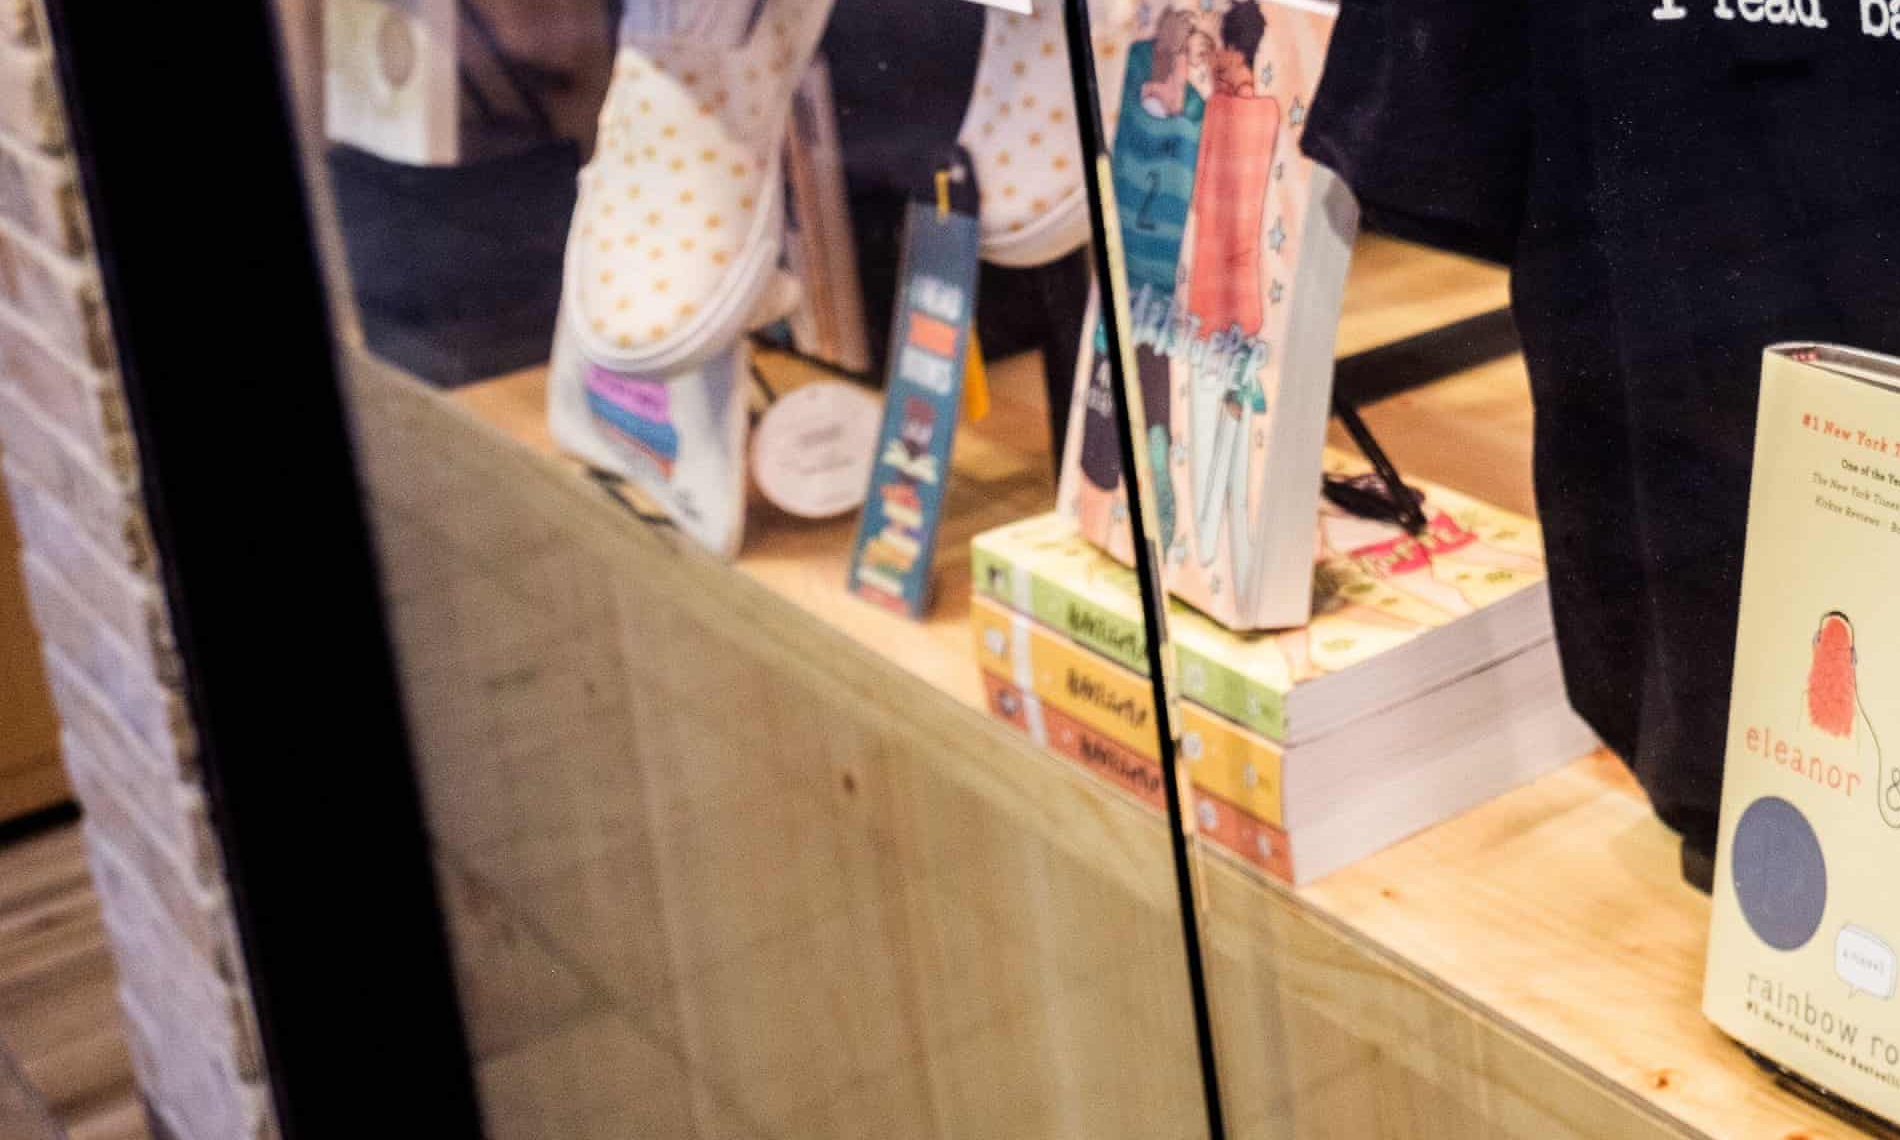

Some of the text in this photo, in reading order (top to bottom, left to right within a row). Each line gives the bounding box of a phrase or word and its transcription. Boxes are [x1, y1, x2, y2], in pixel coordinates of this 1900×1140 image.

[1803, 412, 1819, 431] #1
[1823, 418, 1851, 442] New
[1857, 430, 1888, 454] York
[1842, 459, 1859, 473] One
[1872, 468, 1886, 482] the
[1746, 726, 1861, 796] eleanor
[1747, 972, 1858, 1045] rainbow
